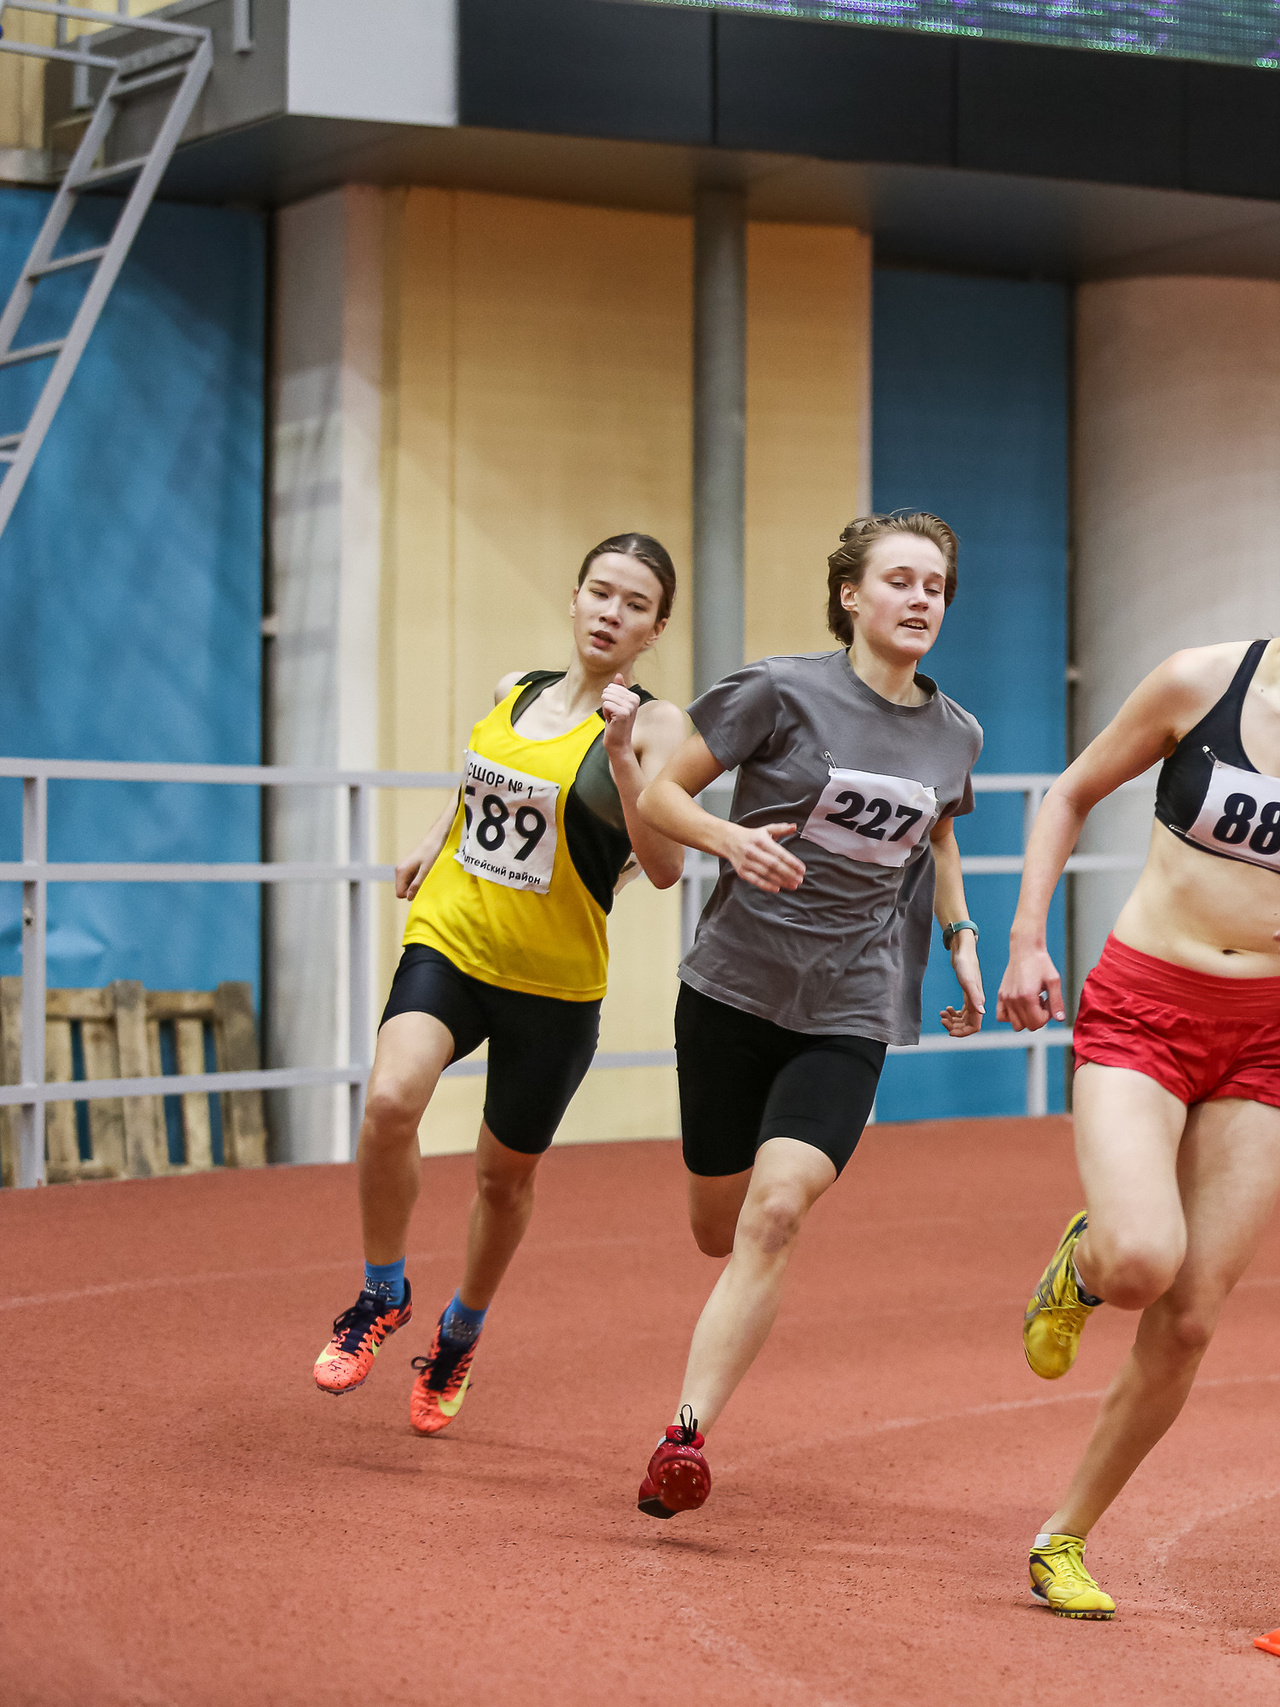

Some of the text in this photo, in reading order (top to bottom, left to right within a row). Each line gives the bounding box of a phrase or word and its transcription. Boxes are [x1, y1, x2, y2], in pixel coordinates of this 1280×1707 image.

[508, 778, 523, 794] №
[527, 786, 534, 799] 1
[825, 790, 923, 841] 227
[508, 870, 541, 885] район
